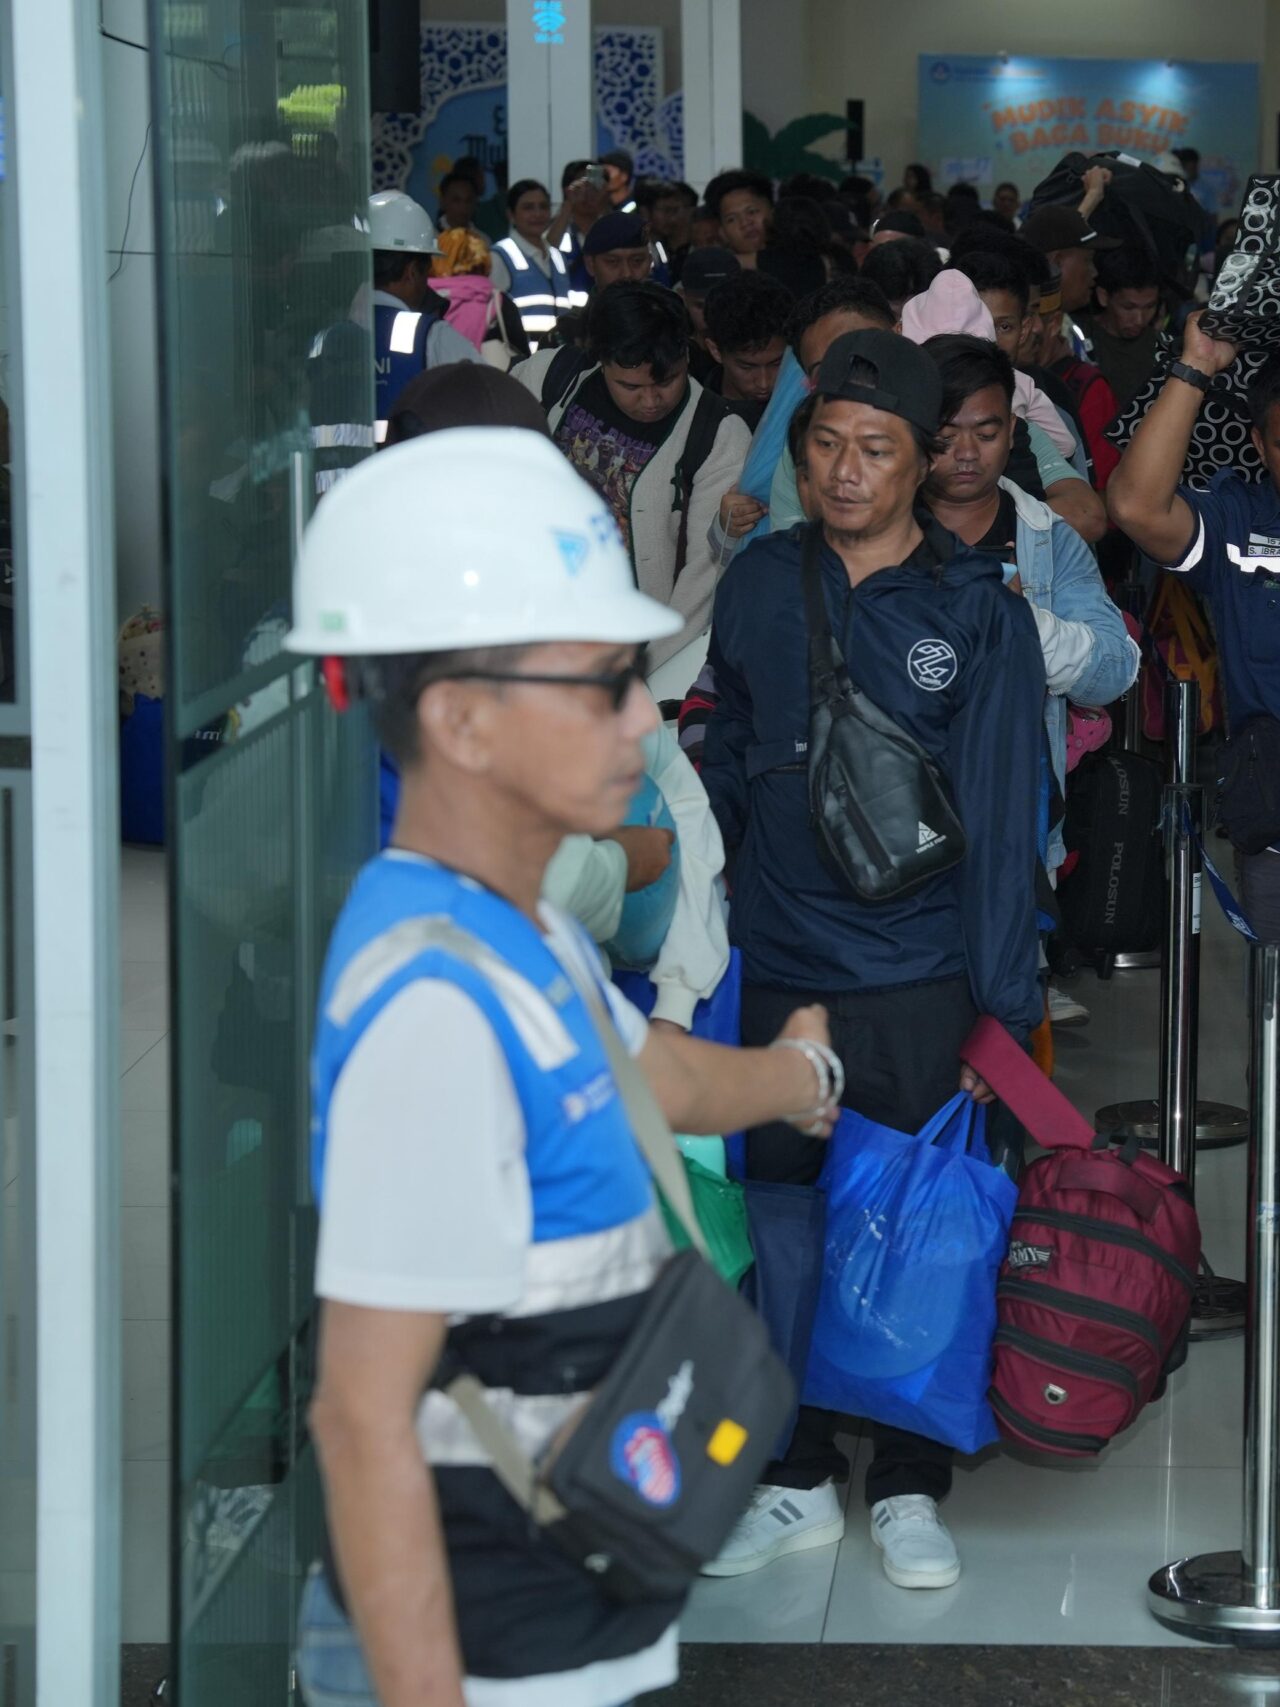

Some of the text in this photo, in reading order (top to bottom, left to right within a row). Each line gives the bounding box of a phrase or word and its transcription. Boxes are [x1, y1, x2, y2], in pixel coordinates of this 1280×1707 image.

[991, 97, 1189, 134] MUDIK ASYIK
[1098, 124, 1171, 153] BUKU
[1249, 547, 1257, 555] S.
[1104, 841, 1125, 924] POLOSUN
